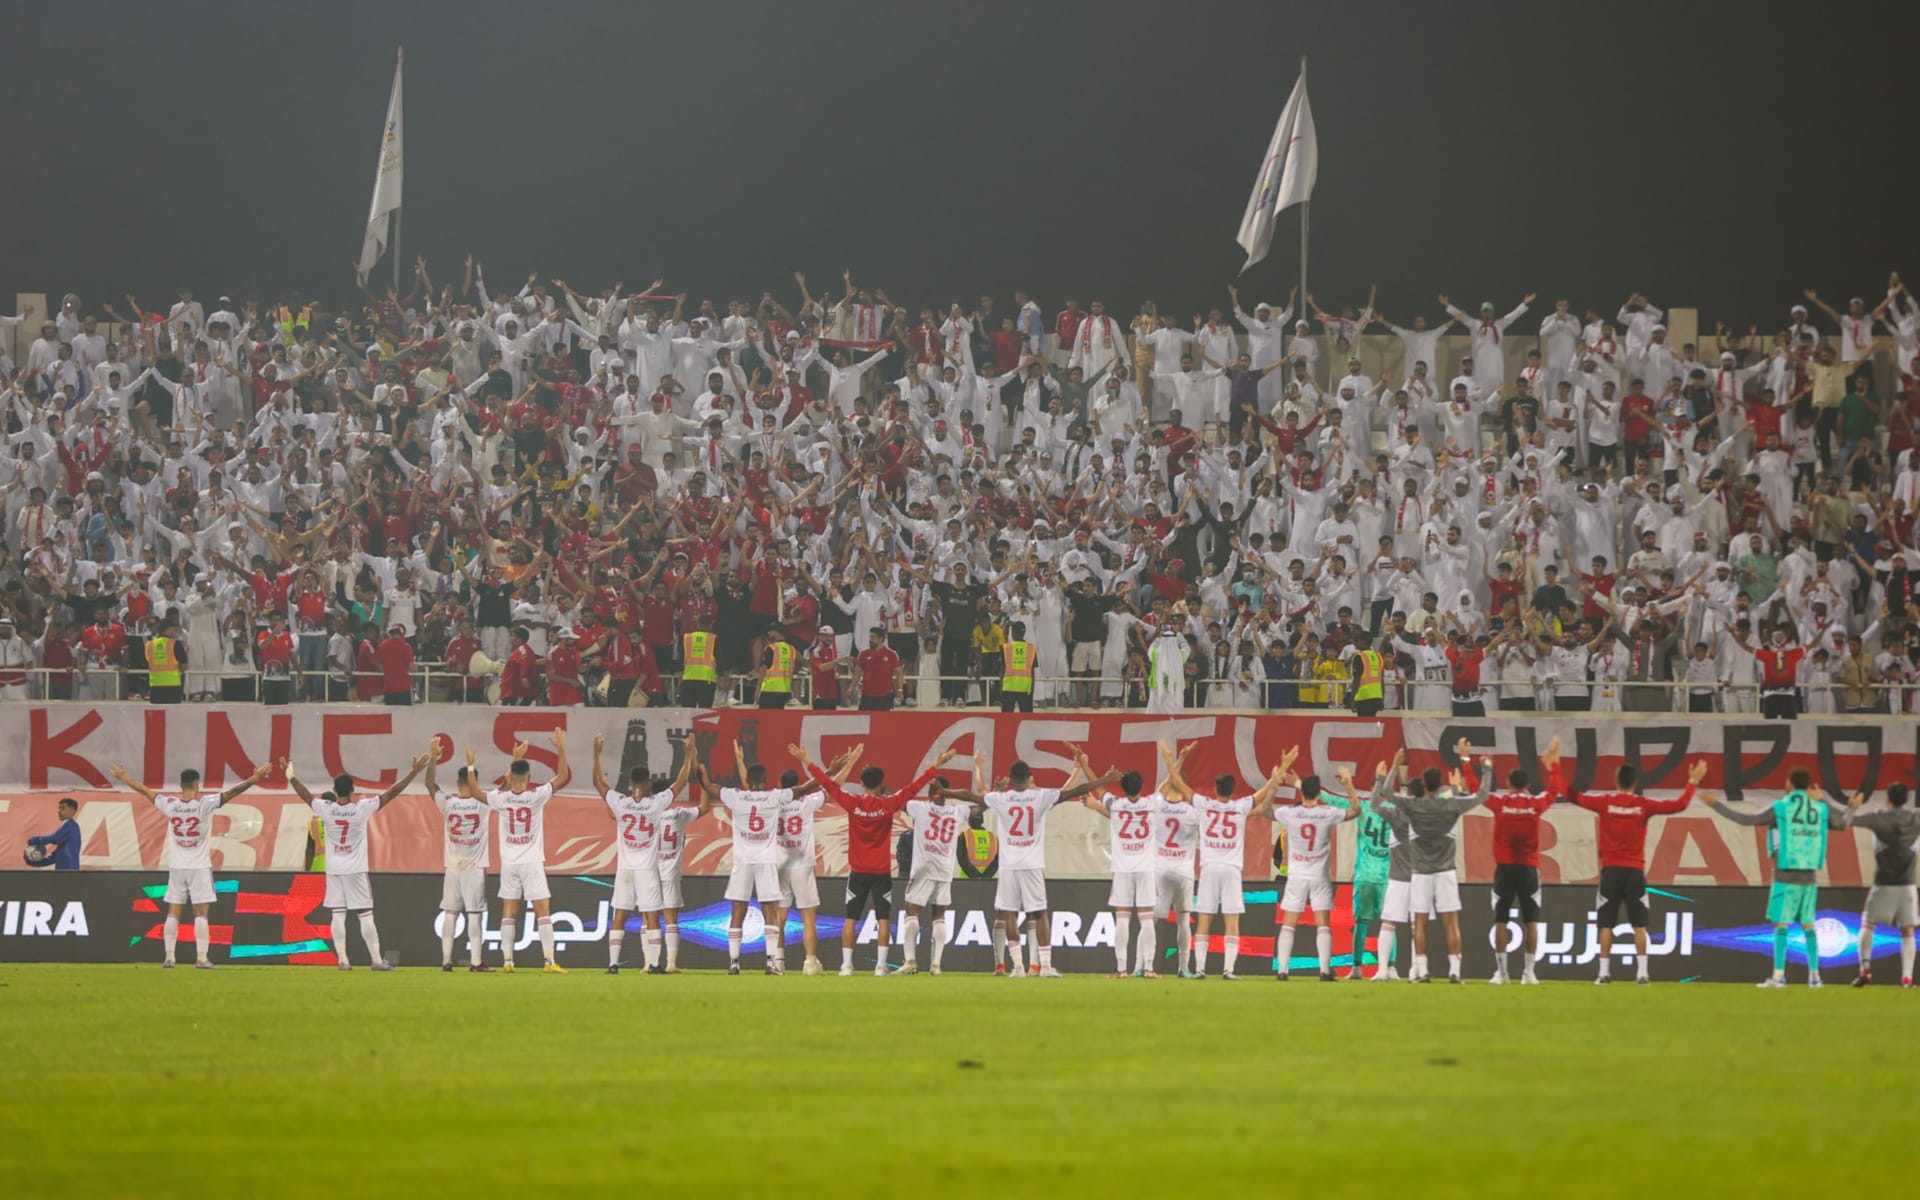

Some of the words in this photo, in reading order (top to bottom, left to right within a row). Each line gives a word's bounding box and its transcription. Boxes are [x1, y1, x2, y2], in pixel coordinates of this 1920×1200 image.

[1439, 724, 1920, 806] SUPPO
[447, 814, 480, 835] 27
[507, 807, 532, 835] 19
[748, 805, 764, 832] 6
[1008, 806, 1034, 836] 21
[1118, 810, 1149, 839] 23
[1206, 809, 1237, 839] 25
[1791, 795, 1819, 825] 26
[170, 817, 200, 837] 22
[334, 820, 349, 844] 7
[622, 814, 654, 840] 24
[924, 811, 956, 844] 30
[1165, 818, 1180, 848] 2
[1300, 823, 1317, 852] 9
